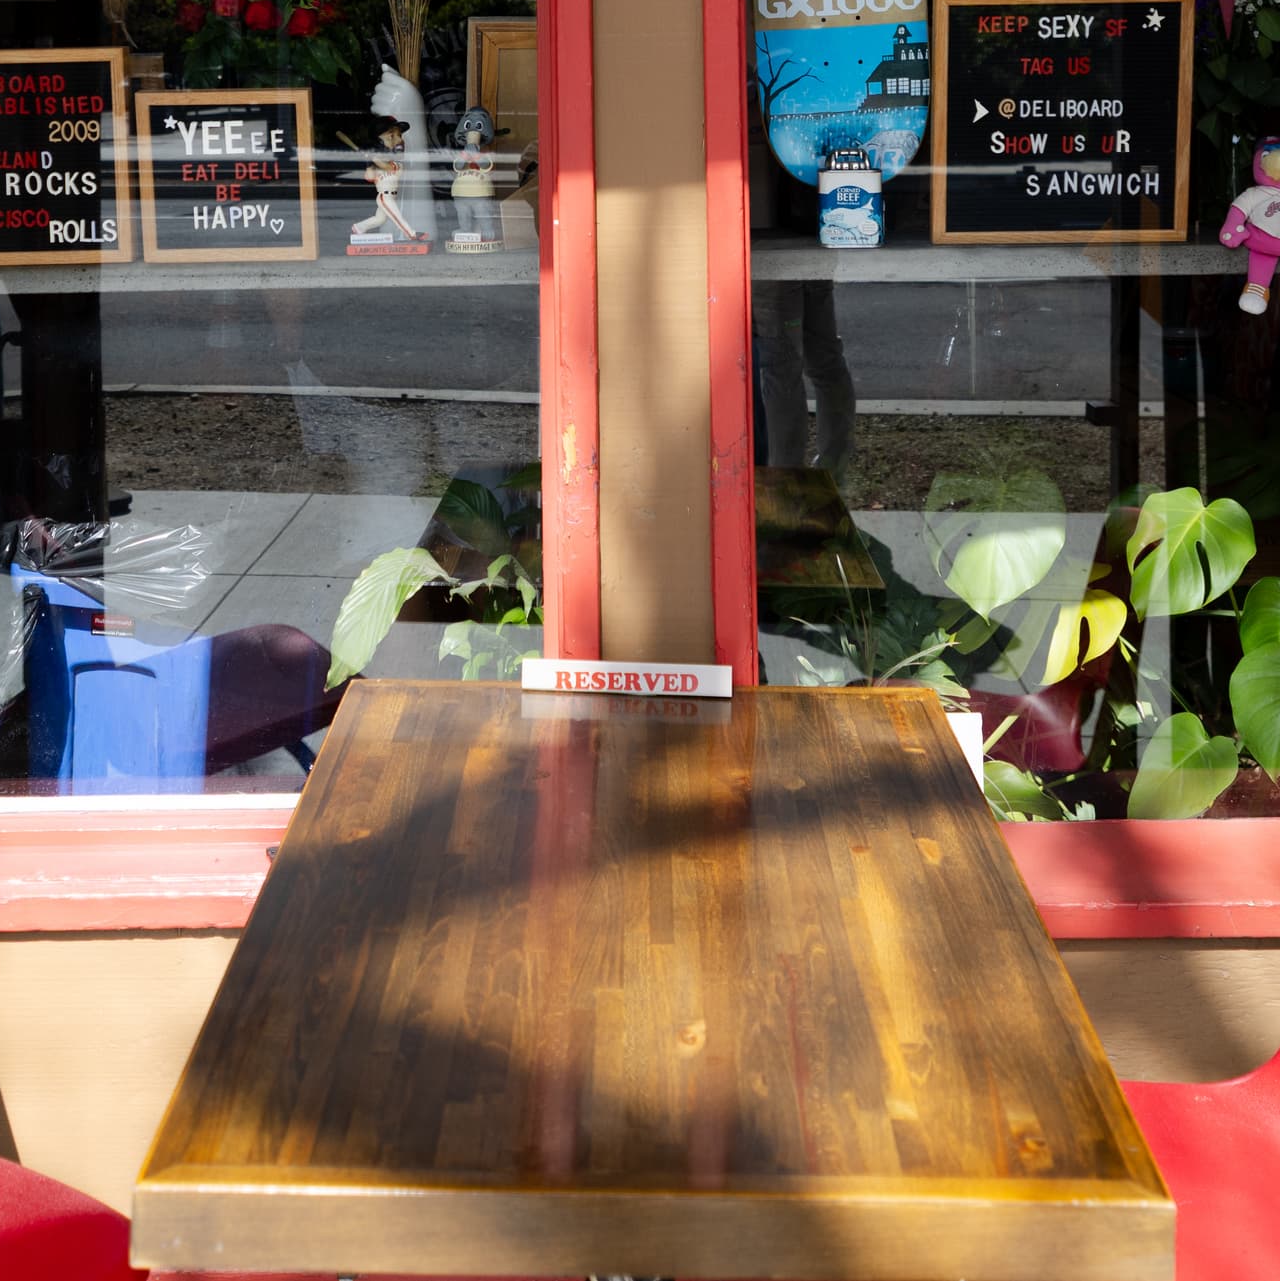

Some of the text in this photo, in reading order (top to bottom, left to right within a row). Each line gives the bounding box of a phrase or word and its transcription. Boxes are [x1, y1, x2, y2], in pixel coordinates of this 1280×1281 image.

[978, 15, 1128, 40] KEEP SEXY SF
[1021, 56, 1091, 76] TAG US
[998, 99, 1124, 119] @DELIBOARD
[49, 120, 101, 142] 2009
[990, 130, 1131, 154] SHOW US UR
[182, 161, 280, 181] EAT DELI
[5, 171, 97, 196] ROCKS
[216, 184, 241, 202] BE
[1026, 171, 1160, 196] SANGWICH
[836, 192, 860, 202] BEEF
[193, 204, 270, 230] HAPPY
[49, 219, 118, 244] ROLLS
[555, 671, 699, 693] RESERVED
